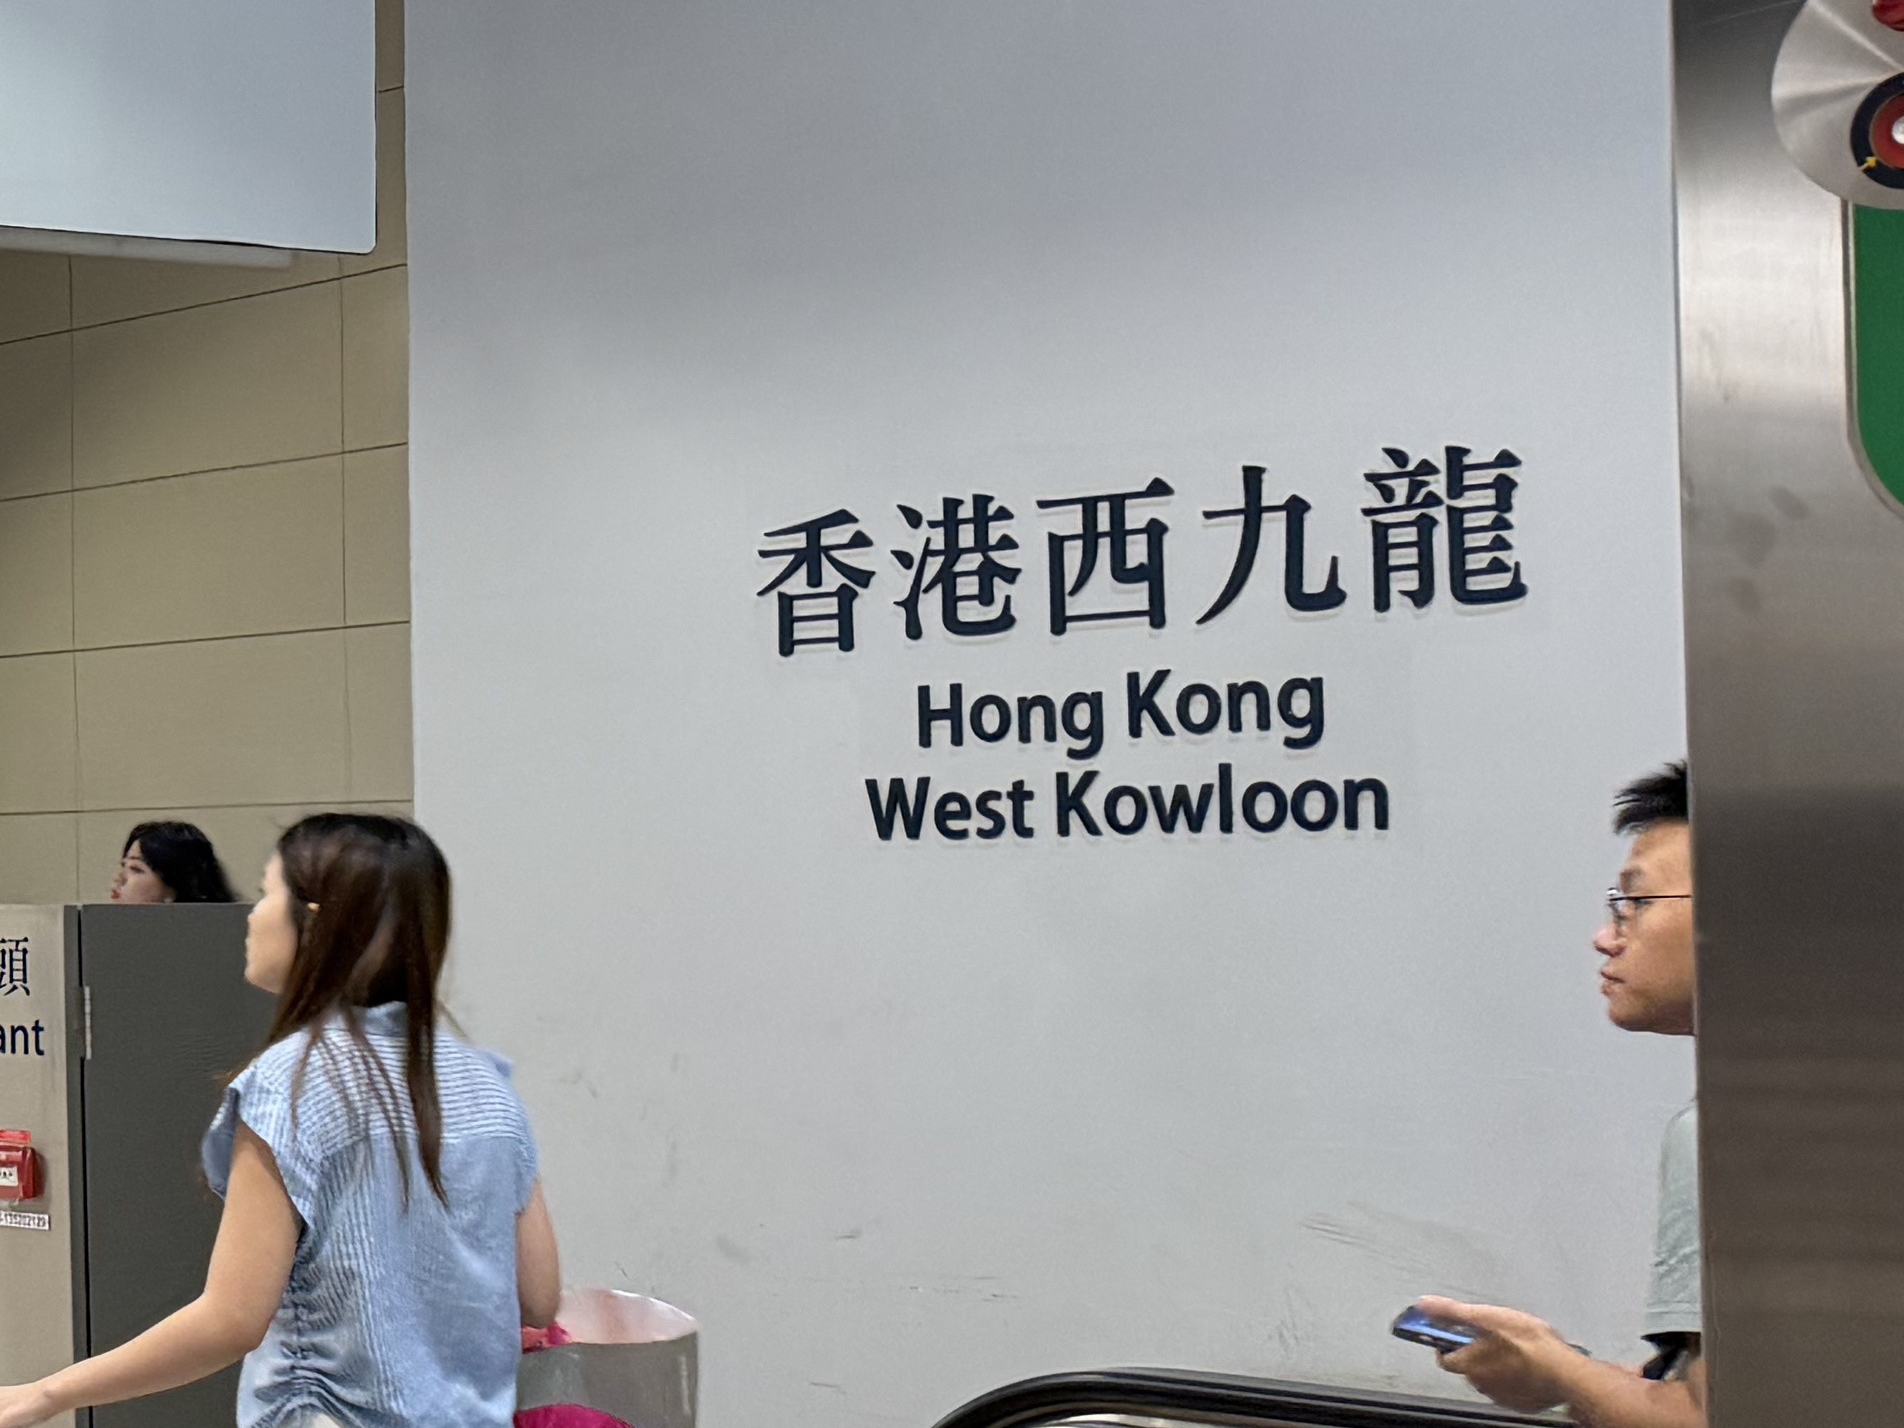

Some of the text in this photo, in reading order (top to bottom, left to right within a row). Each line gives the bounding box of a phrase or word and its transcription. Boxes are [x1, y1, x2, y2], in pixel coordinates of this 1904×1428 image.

[757, 444, 1530, 657] 香港西九龍
[916, 668, 1325, 759] Hong Kong
[865, 763, 1390, 840] West Kowloon
